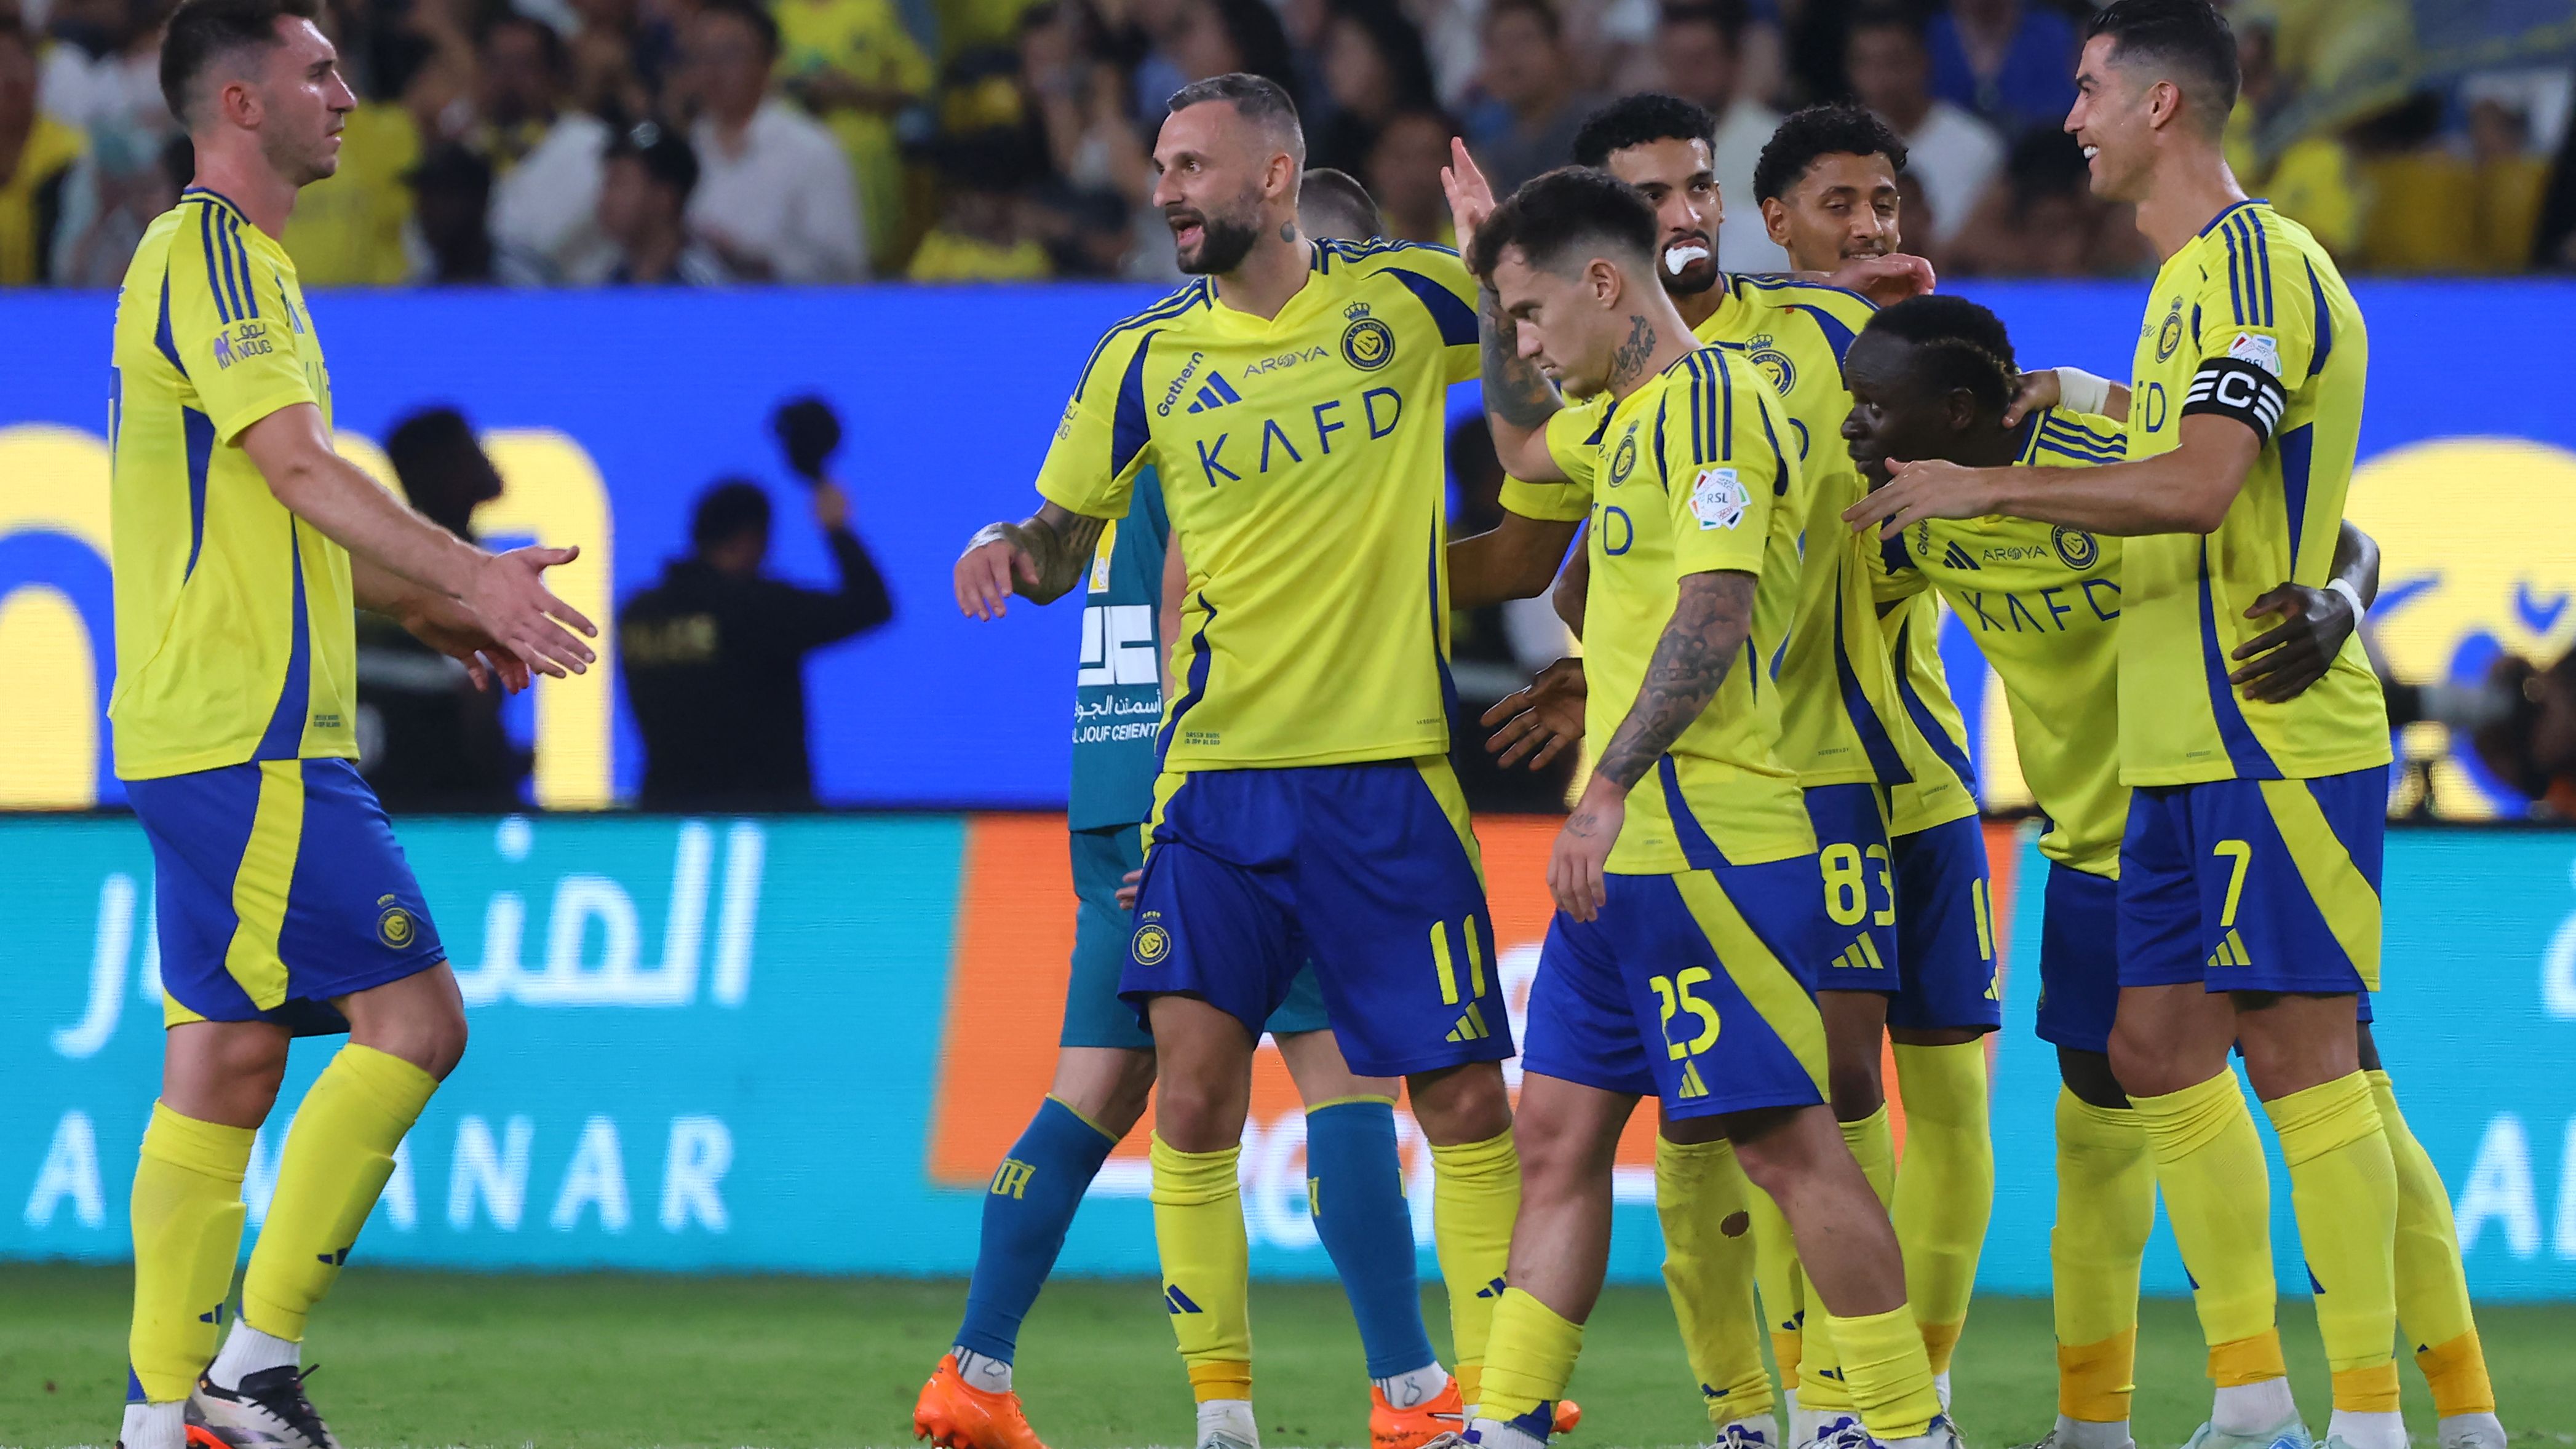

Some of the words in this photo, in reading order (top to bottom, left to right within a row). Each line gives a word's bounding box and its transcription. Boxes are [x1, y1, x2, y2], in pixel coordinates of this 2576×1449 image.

[1156, 351, 1204, 417] Gathern
[1243, 346, 1329, 379] AROYA
[2216, 371, 2257, 408] C
[1196, 386, 1402, 488] KAFD
[1707, 492, 1728, 504] RSL
[1982, 545, 2048, 562] AROYA
[1961, 578, 2120, 633] KAFD
[1079, 724, 1111, 743] JOUF
[1819, 843, 1895, 926] 83
[2213, 840, 2252, 927] 7
[1429, 914, 1485, 1005] 11
[1649, 966, 1721, 1061] 25
